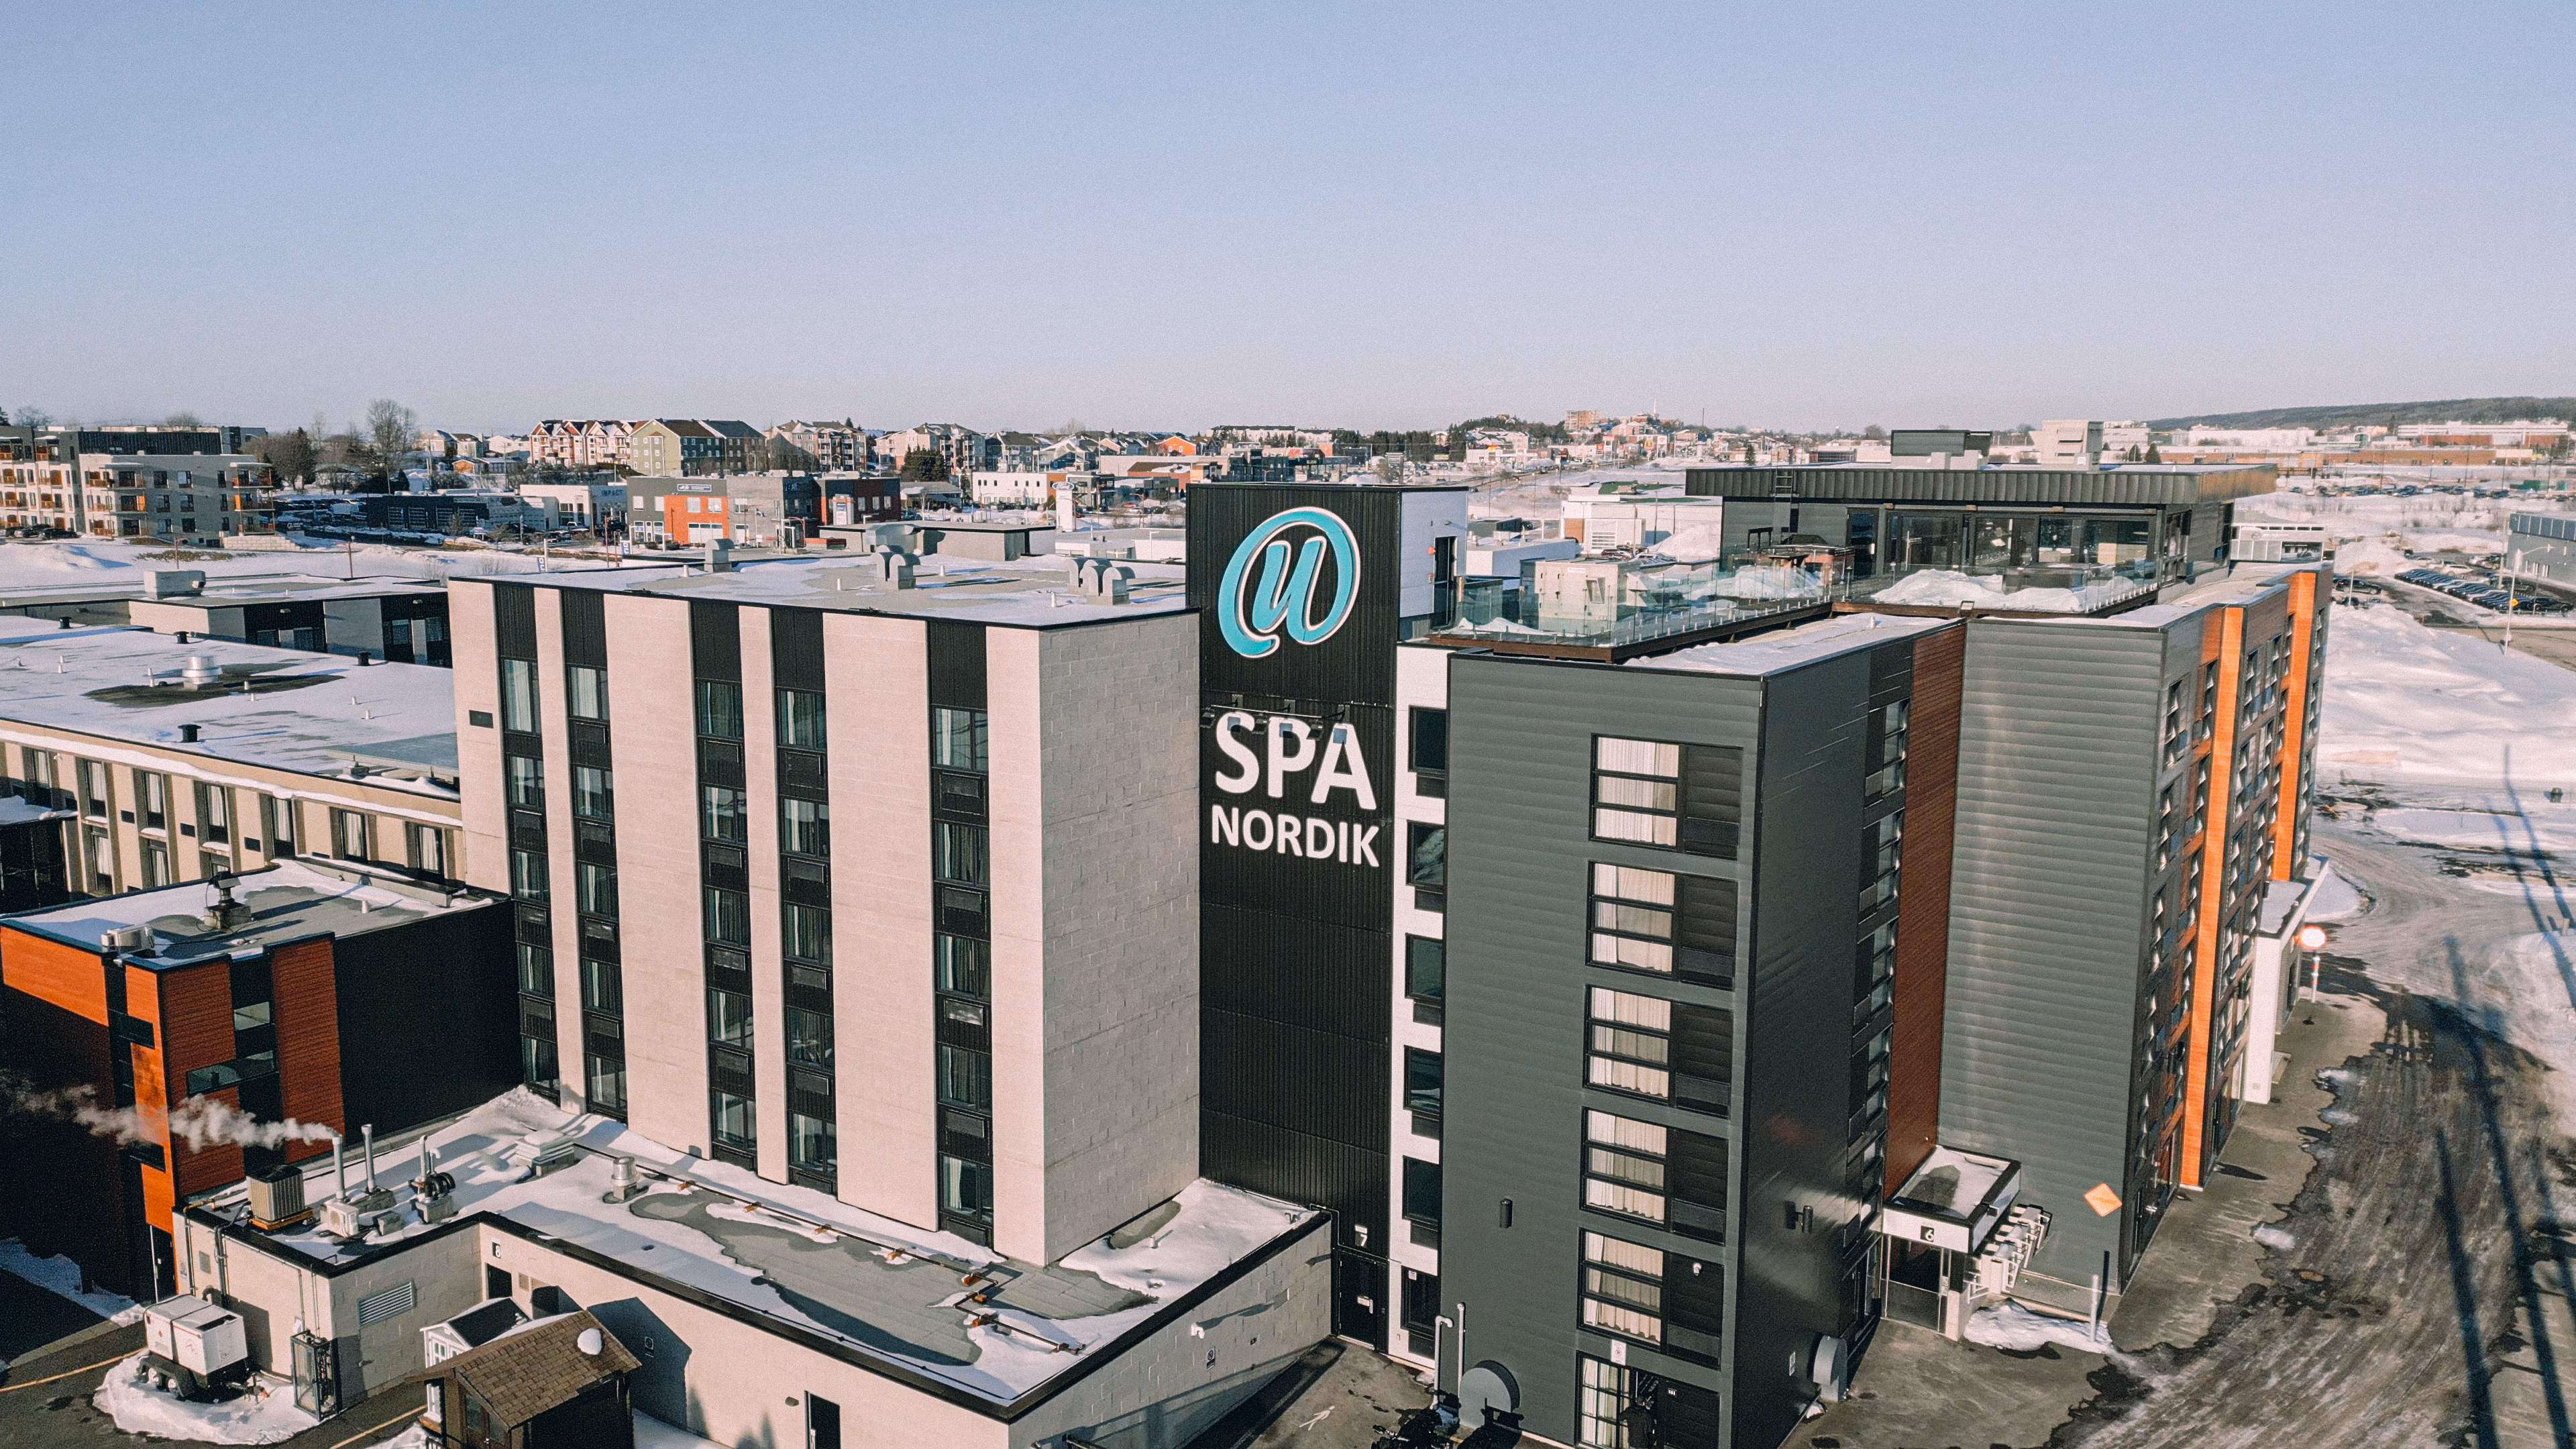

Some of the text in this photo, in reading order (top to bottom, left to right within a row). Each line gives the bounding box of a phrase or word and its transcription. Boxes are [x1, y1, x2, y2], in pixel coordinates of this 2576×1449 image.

[1215, 711, 1377, 810] SPA
[1212, 804, 1380, 867] NORDIK
[1360, 1234, 1368, 1246] 7
[1925, 1229, 1934, 1241] 6
[495, 1245, 501, 1258] 8
